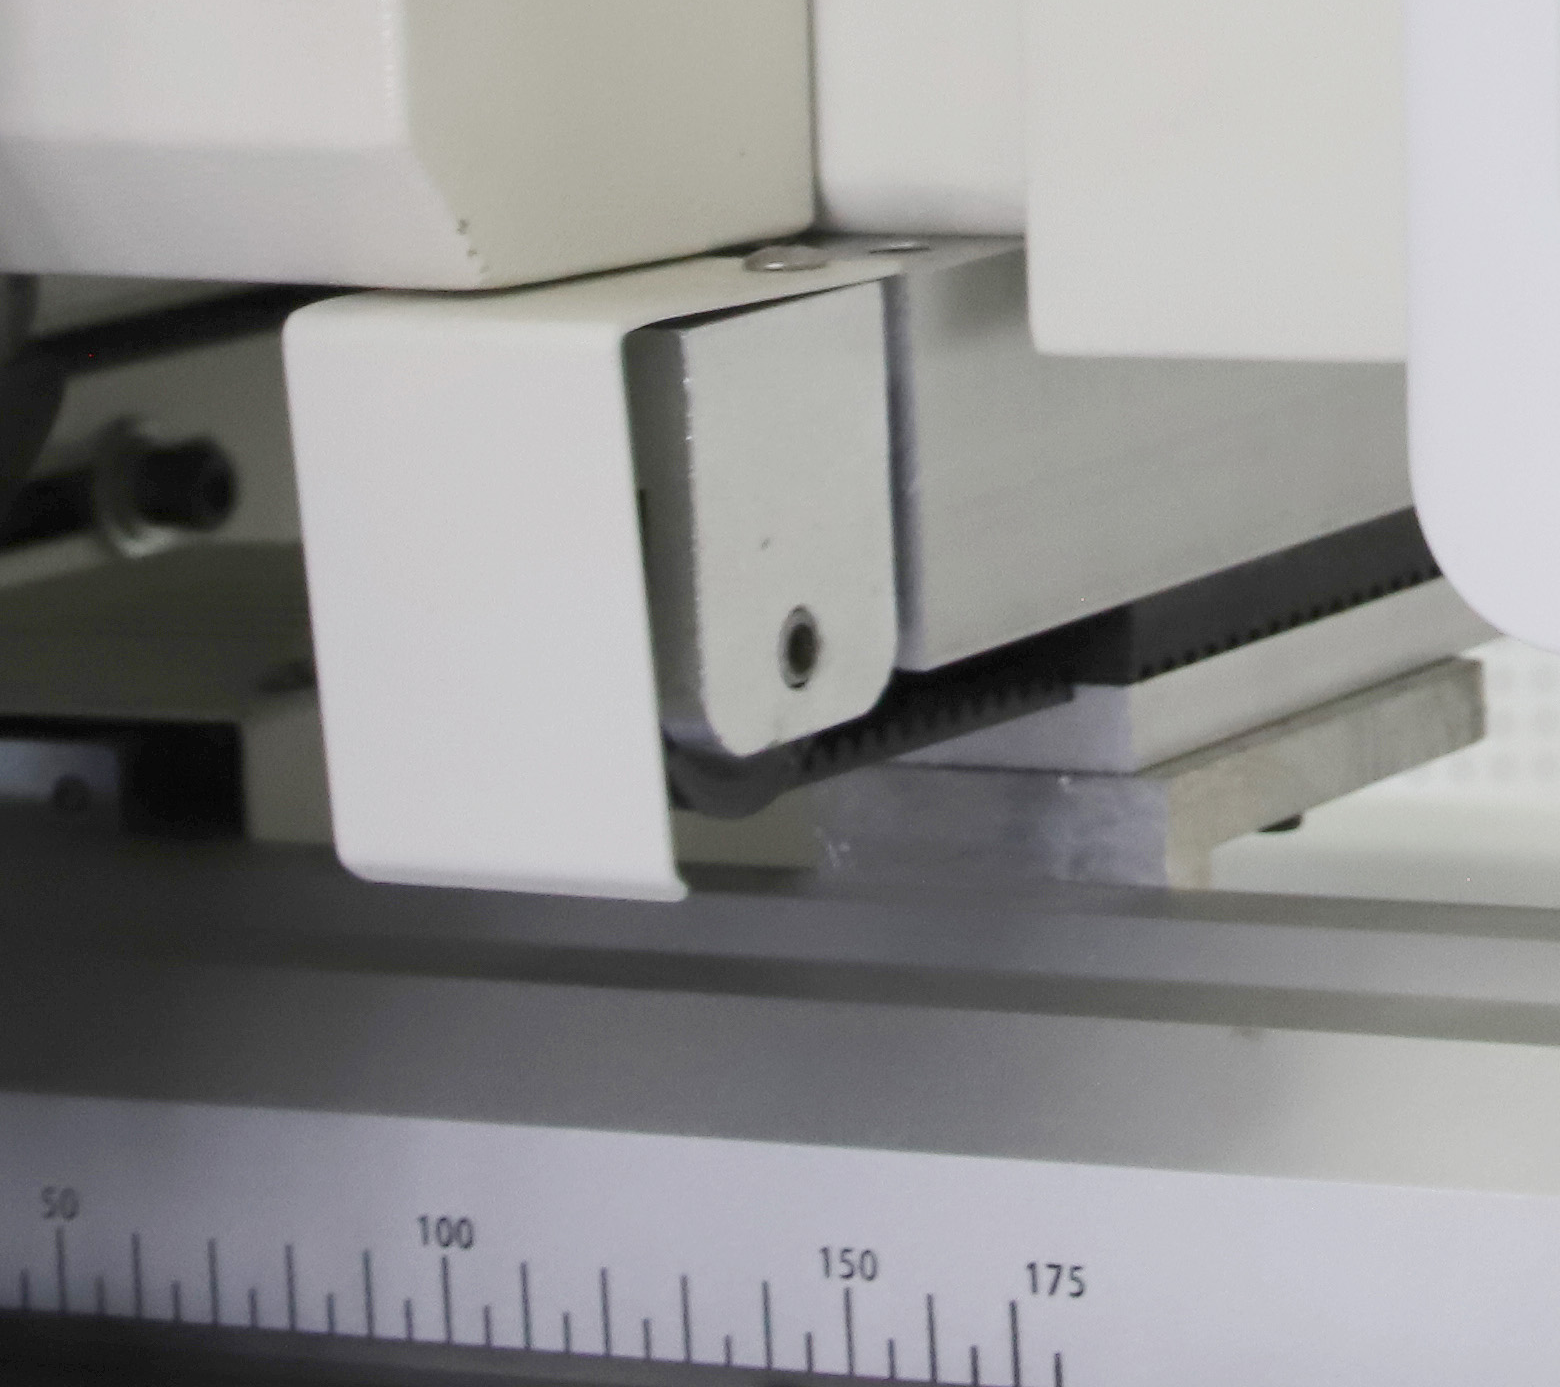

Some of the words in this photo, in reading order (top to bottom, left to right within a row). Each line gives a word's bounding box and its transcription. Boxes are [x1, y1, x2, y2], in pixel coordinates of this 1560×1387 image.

[40, 1186, 80, 1221] 50
[417, 1214, 476, 1250] 100
[818, 1245, 880, 1282] 150
[1025, 1261, 1087, 1299] 175
